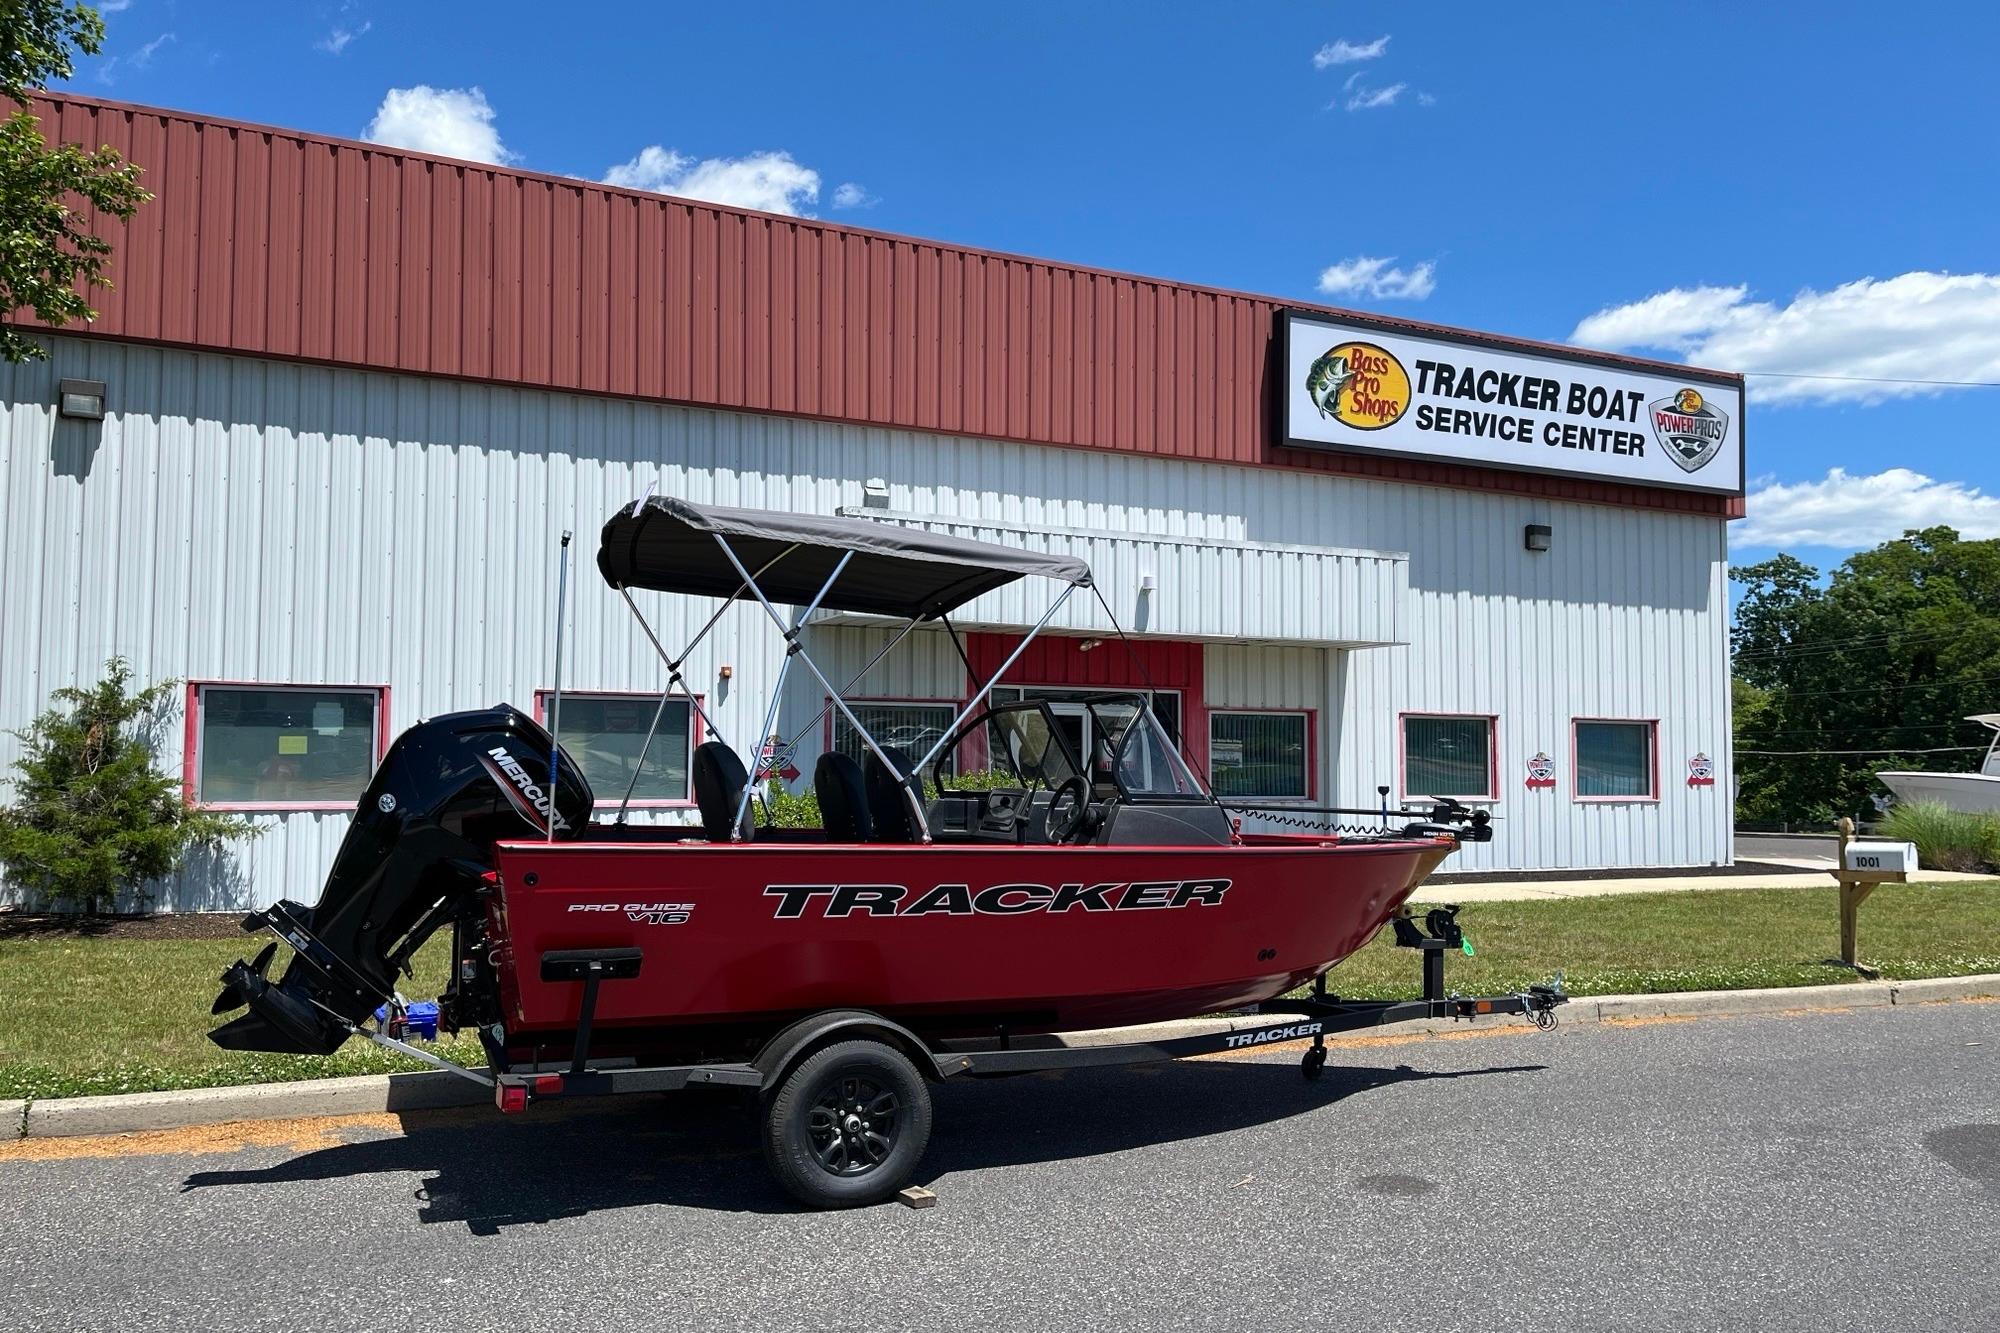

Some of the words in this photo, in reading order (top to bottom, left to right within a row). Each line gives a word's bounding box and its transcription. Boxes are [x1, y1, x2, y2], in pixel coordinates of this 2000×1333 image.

[1349, 347, 1389, 375] Bass
[1350, 370, 1380, 395] Pro
[1415, 359, 1561, 412] TRACKER
[1566, 383, 1645, 423] BOAT
[1350, 391, 1399, 422] Shops
[1415, 404, 1535, 444] SERVICE
[1543, 421, 1646, 457] CENTER
[1655, 411, 1722, 441] POWERPROS
[487, 746, 572, 830] MERCURY
[1856, 856, 1880, 868] 1001
[567, 904, 620, 912] PRO
[623, 903, 696, 911] GUIDE
[763, 879, 1233, 918] TRACKER
[626, 911, 690, 925] V16
[1226, 1022, 1323, 1048] TRACKER
